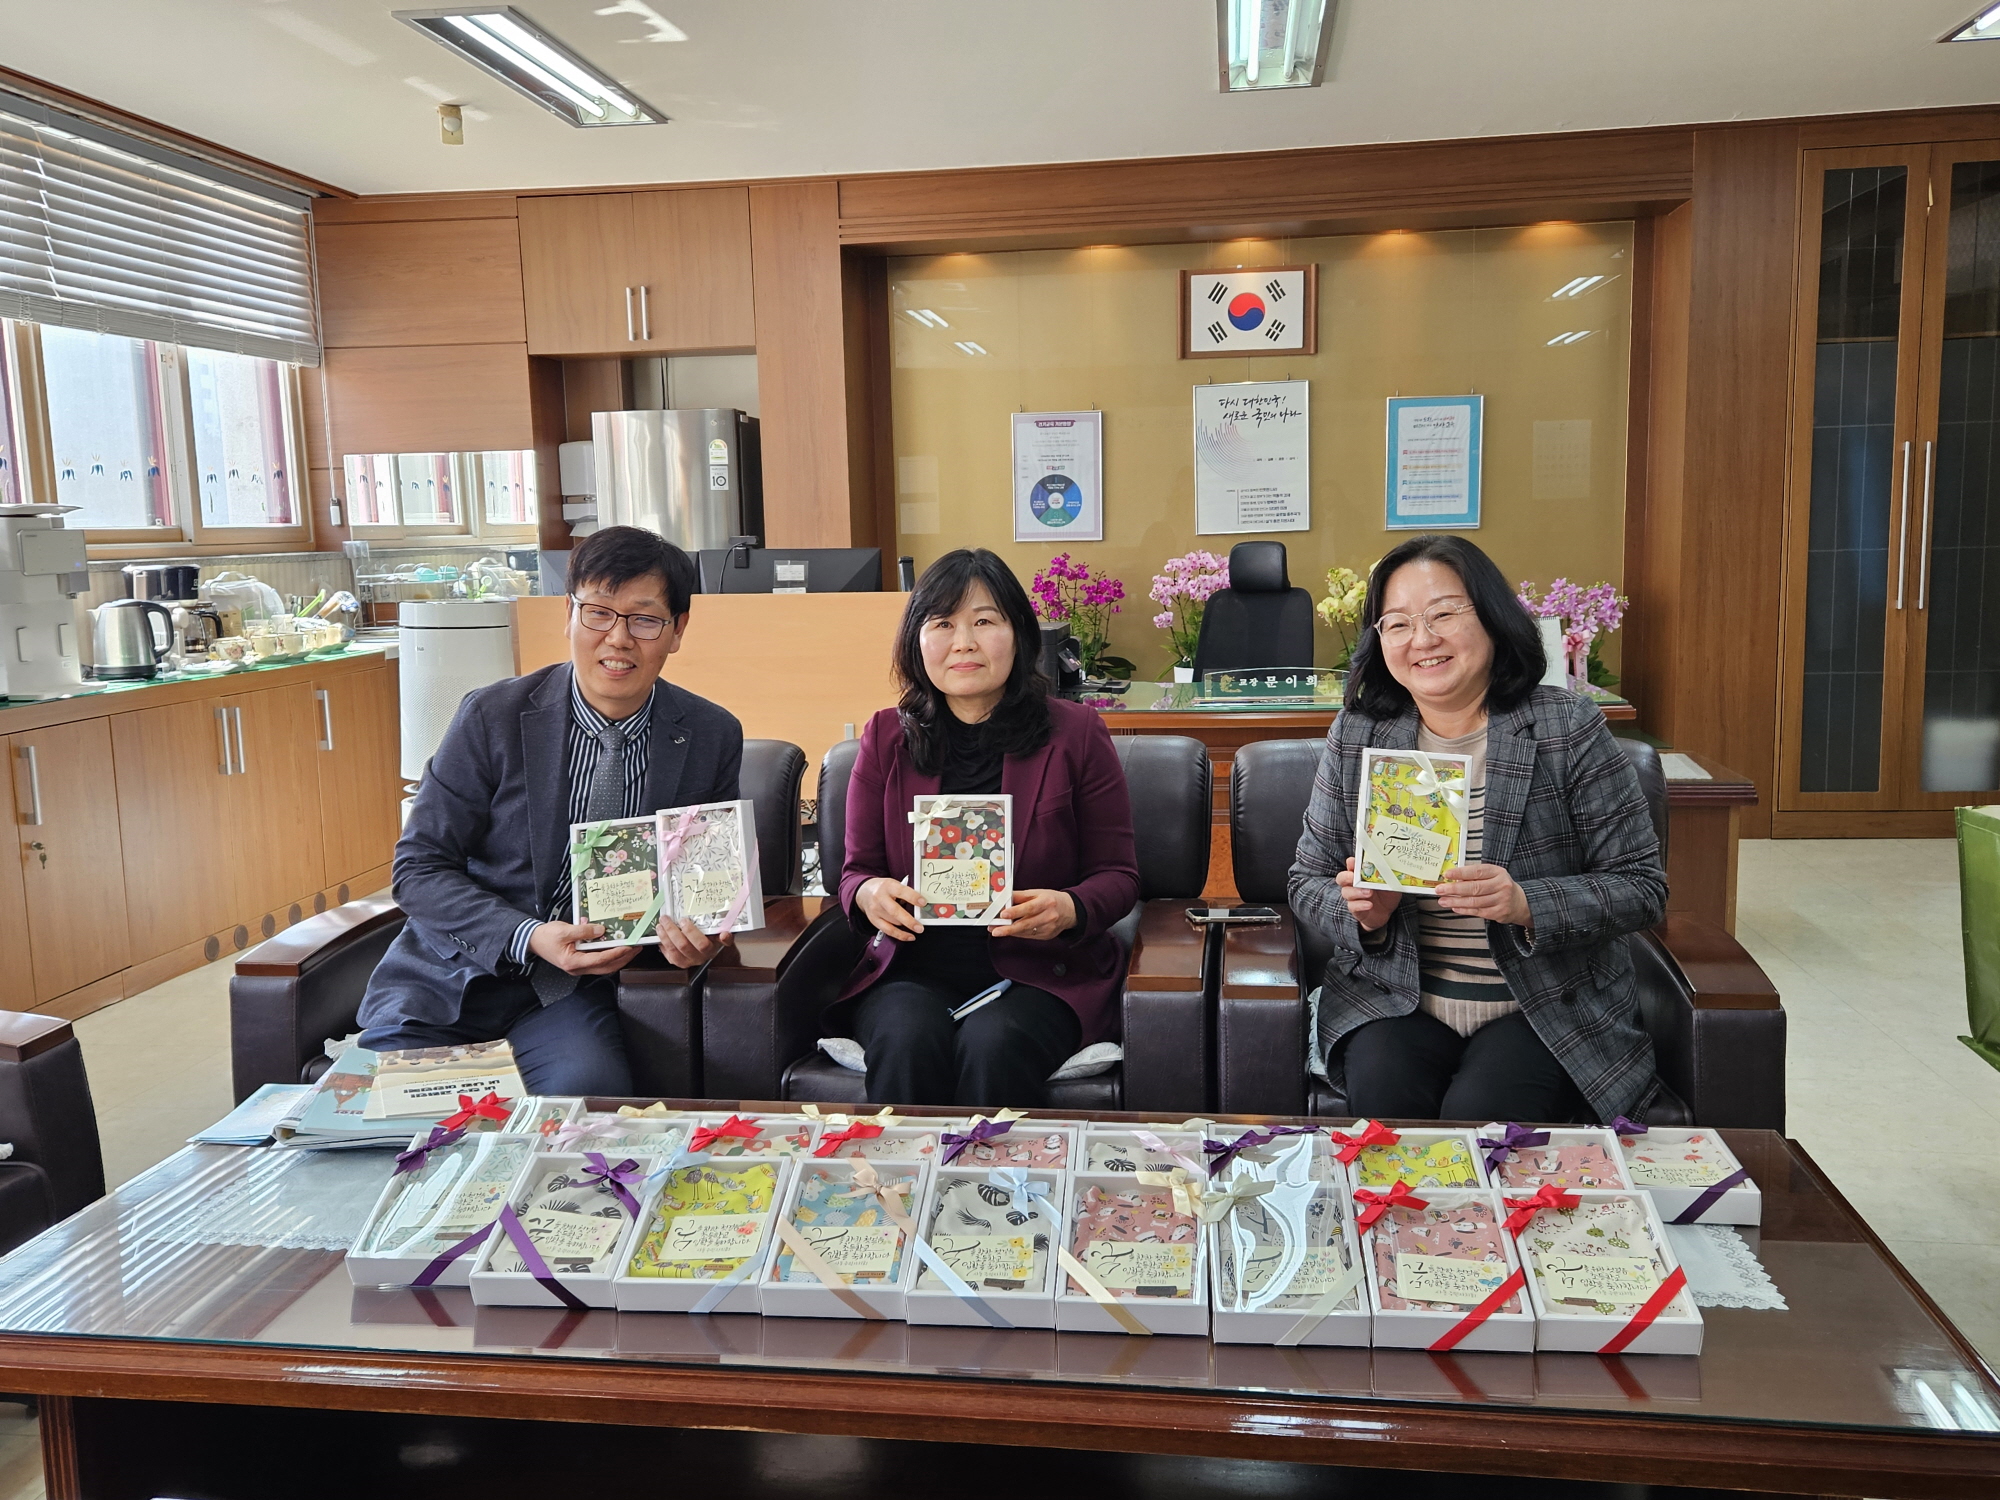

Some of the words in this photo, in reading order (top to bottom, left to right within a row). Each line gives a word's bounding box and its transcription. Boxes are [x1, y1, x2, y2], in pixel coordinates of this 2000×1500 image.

[1219, 397, 1240, 409] 다시
[1242, 394, 1287, 409] 대한민국!
[1223, 411, 1249, 426] 새로운
[1252, 408, 1277, 428] 국민의
[1280, 407, 1303, 423] 나라
